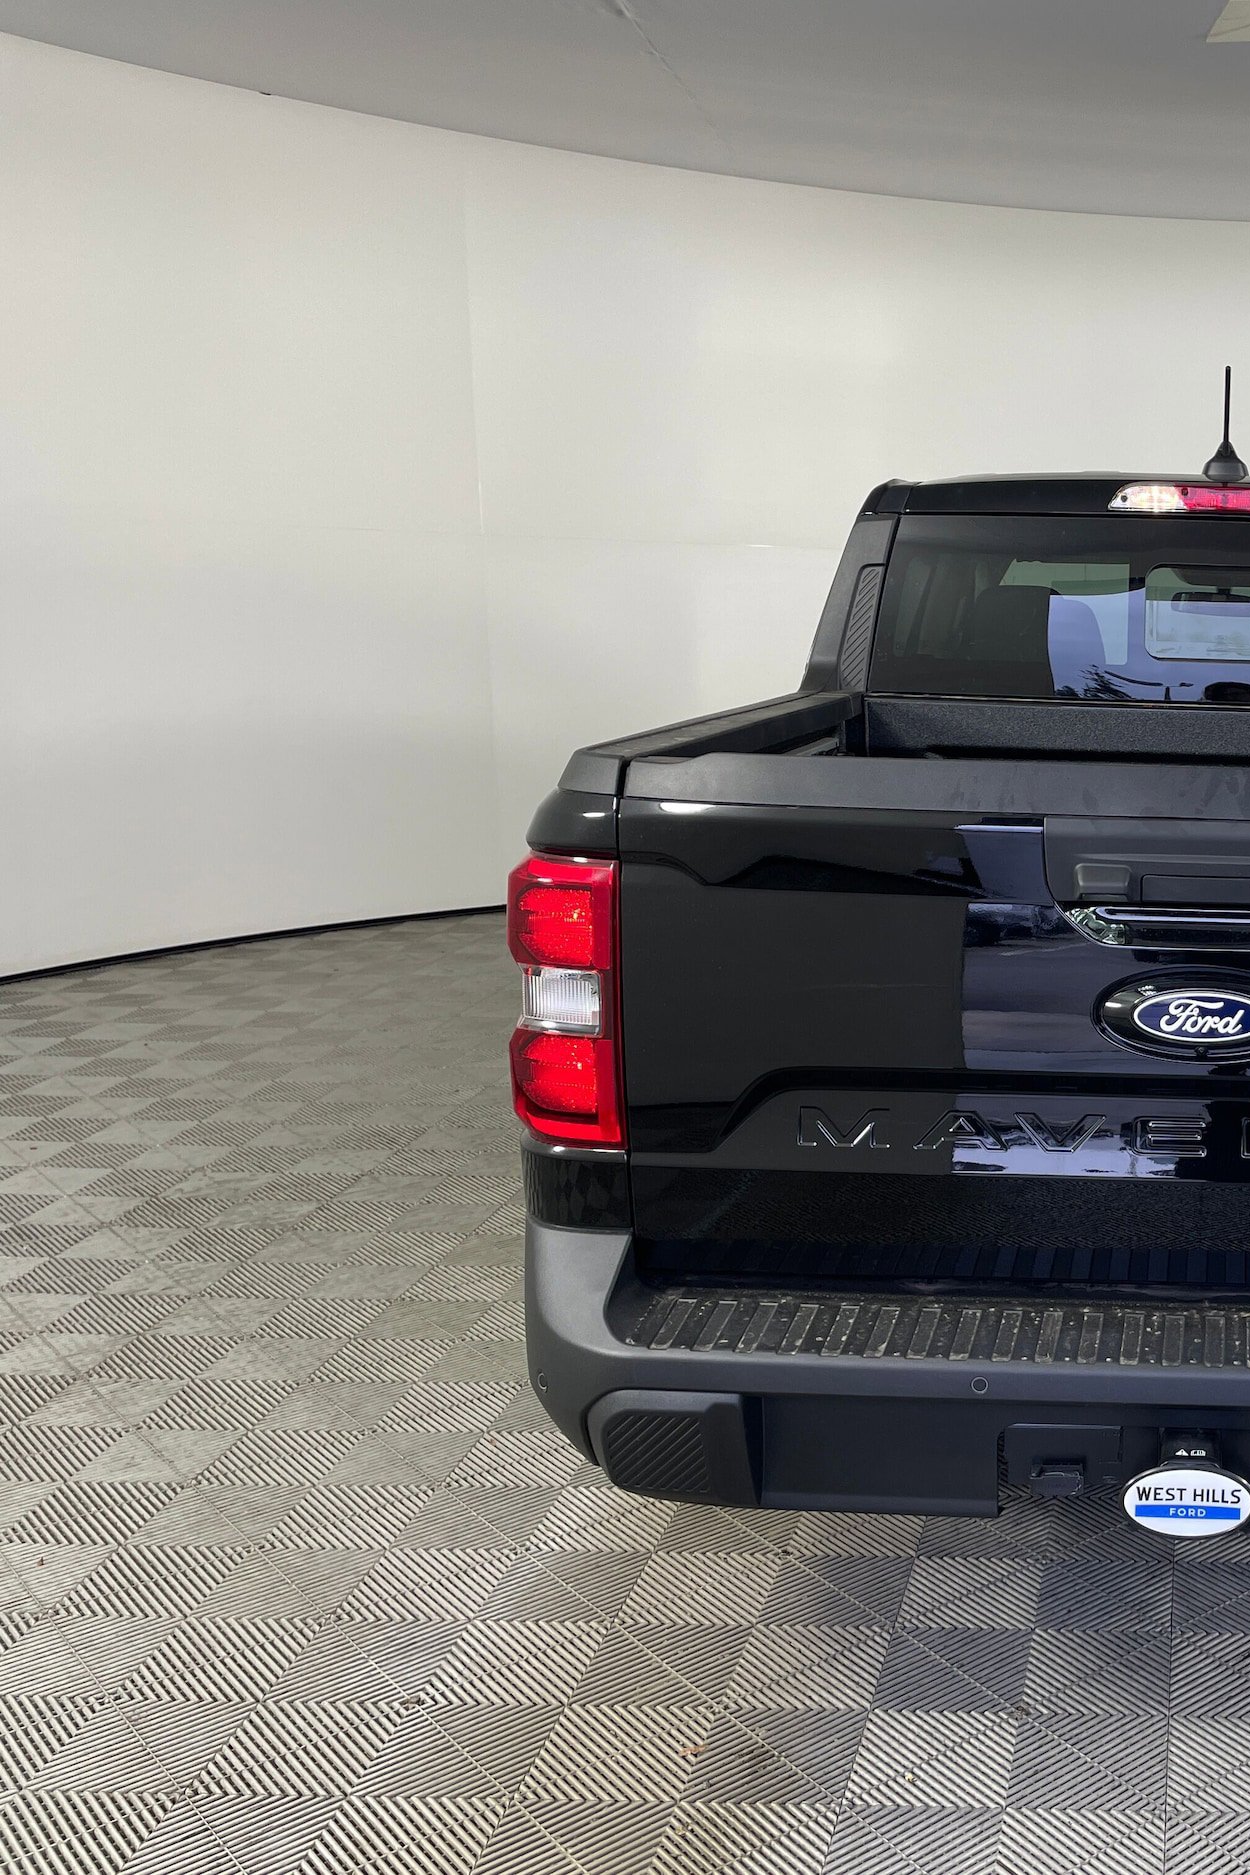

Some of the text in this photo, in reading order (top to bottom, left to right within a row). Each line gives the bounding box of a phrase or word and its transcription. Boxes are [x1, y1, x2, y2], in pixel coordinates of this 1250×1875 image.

[1160, 999, 1245, 1035] Ford
[1136, 1486, 1241, 1504] WEST HILLS
[1169, 1507, 1206, 1517] FORD
